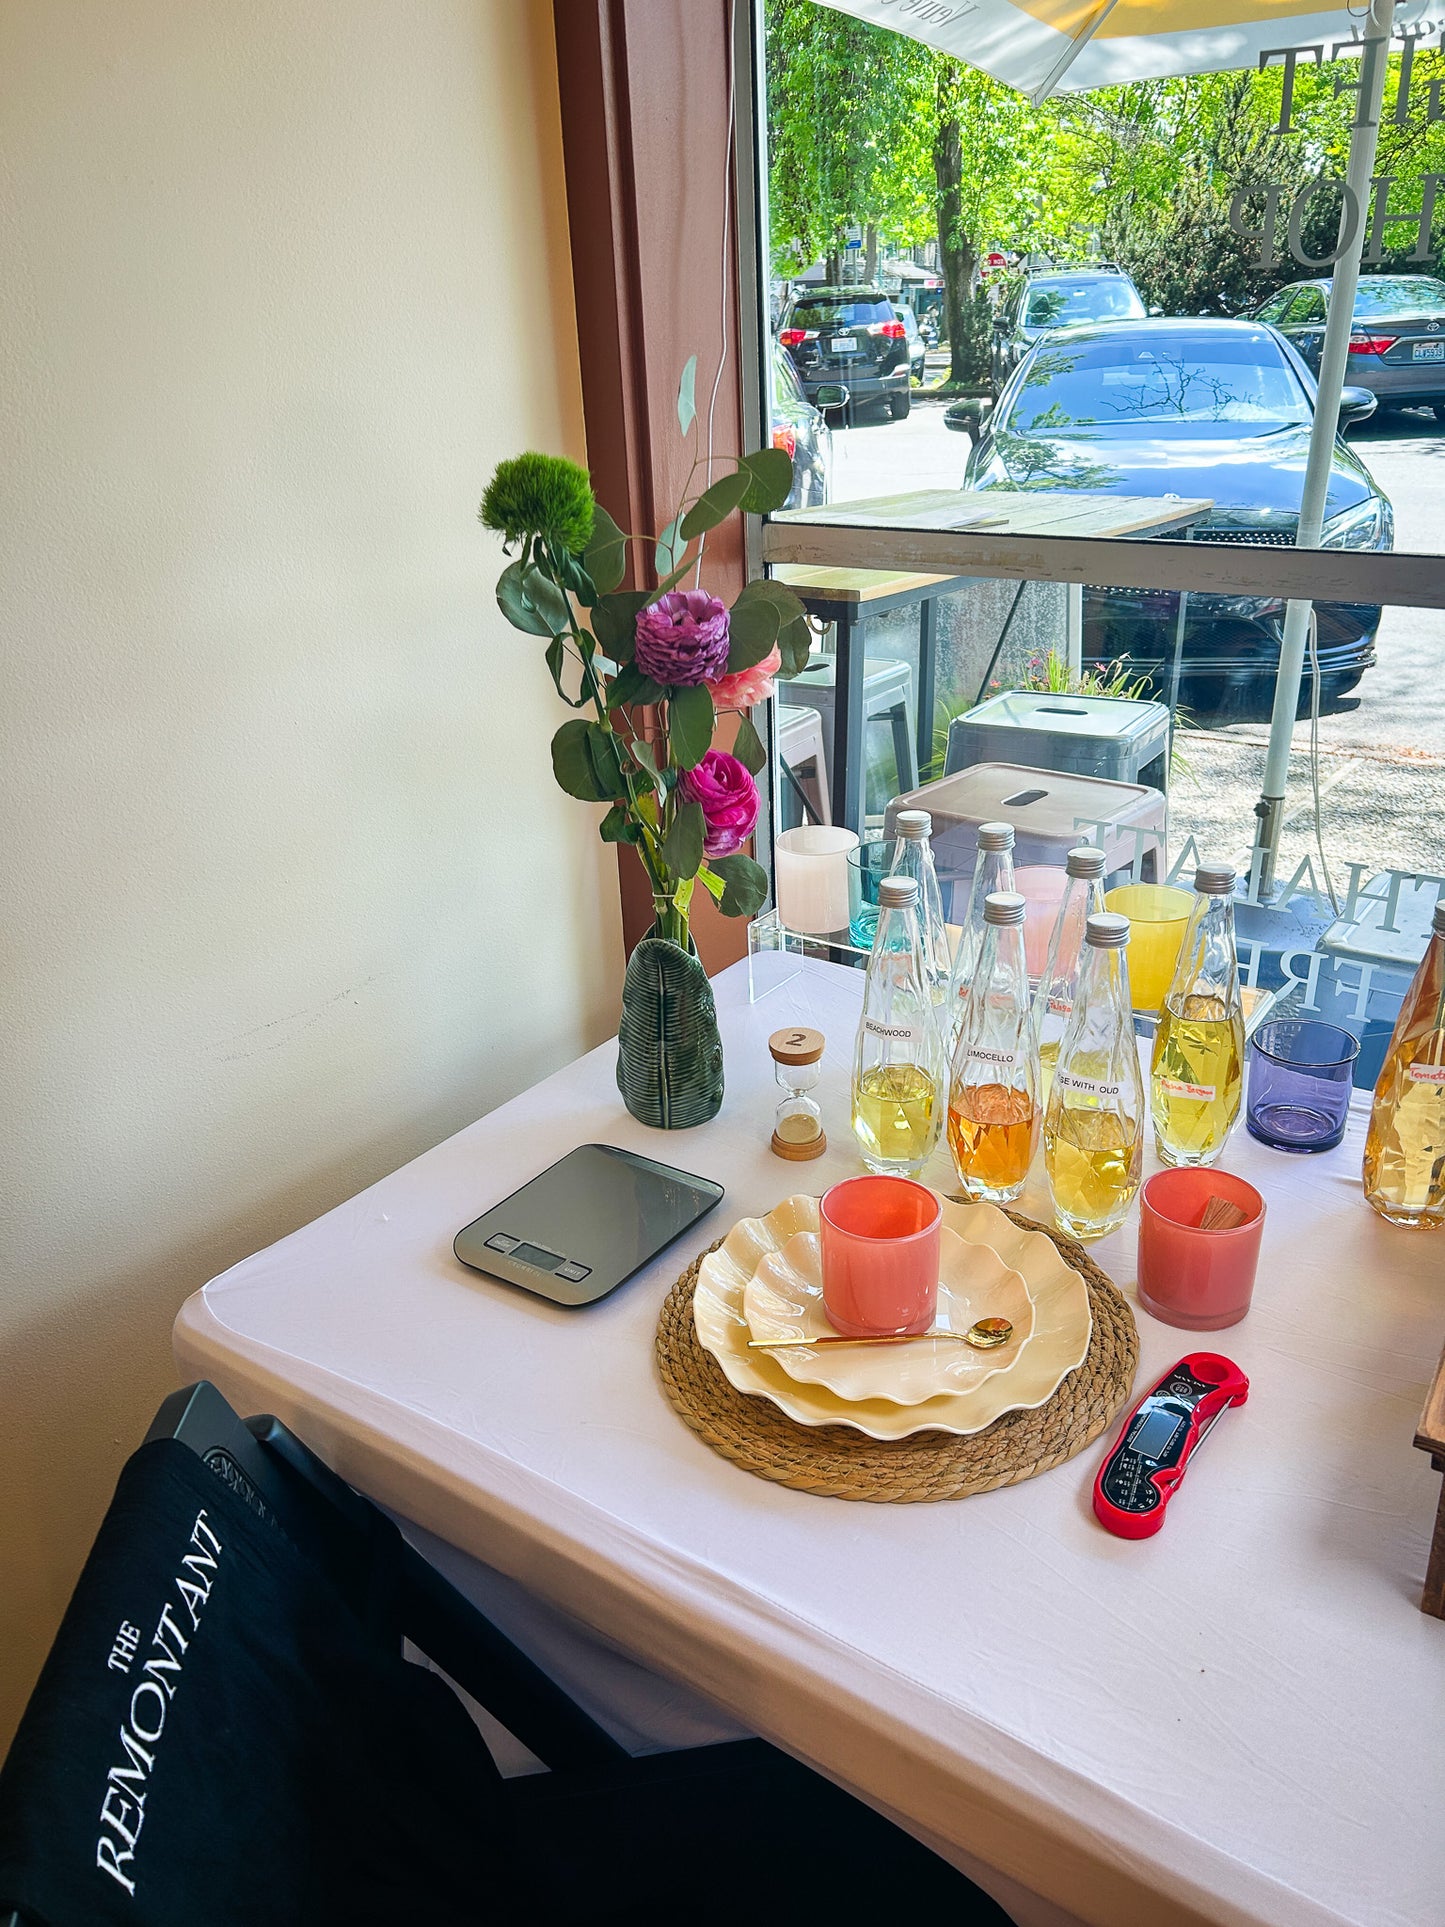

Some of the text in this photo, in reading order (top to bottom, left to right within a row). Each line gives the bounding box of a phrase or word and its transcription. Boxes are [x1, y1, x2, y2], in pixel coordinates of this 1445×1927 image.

[865, 1021, 911, 1038] BEACHWOOD
[785, 1033, 806, 1046] 2
[966, 1049, 1014, 1063] LIMOCELLO
[1072, 1079, 1095, 1091] WITH
[1099, 1086, 1119, 1095] OUD
[108, 1619, 141, 1673] THE
[97, 1509, 222, 1897] REMONTANT
